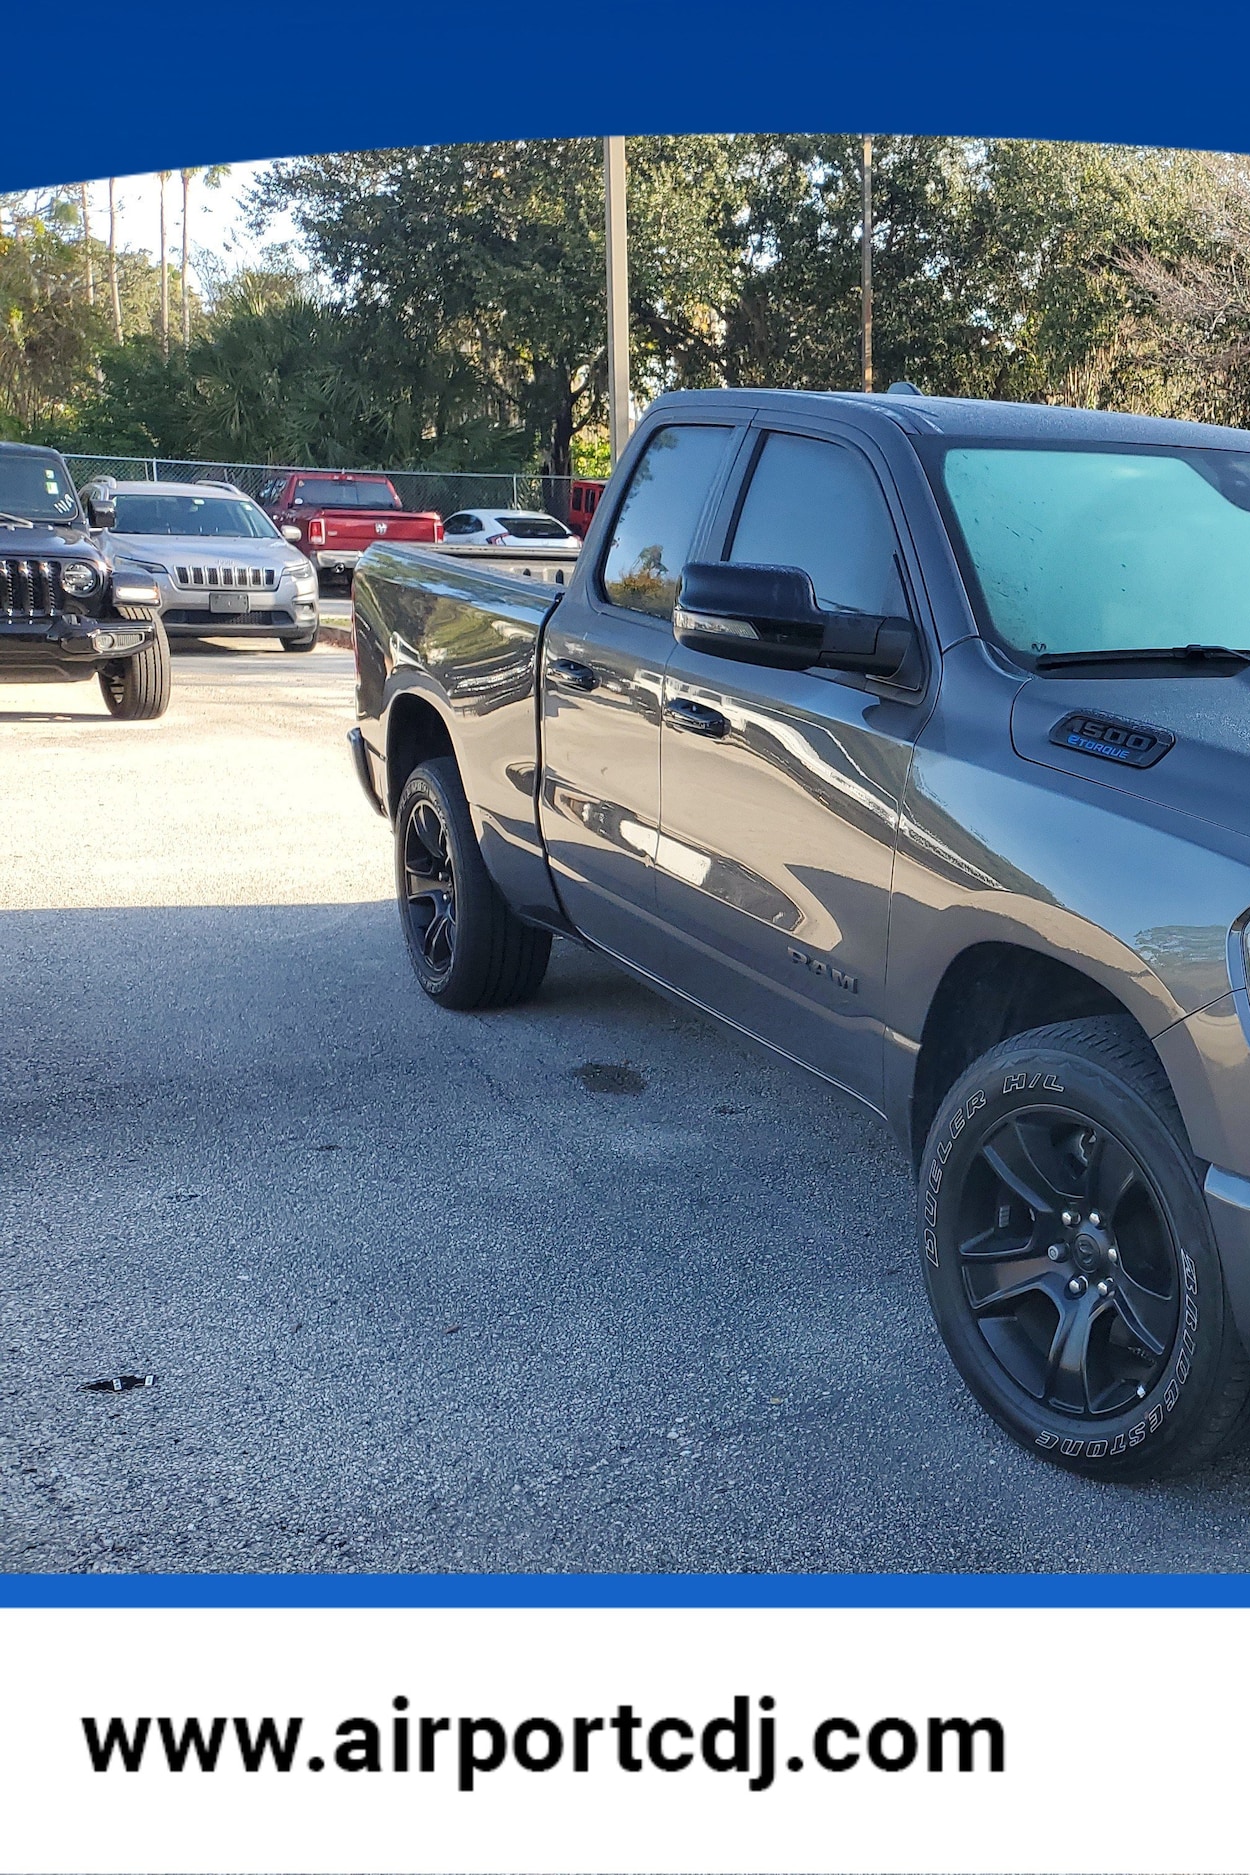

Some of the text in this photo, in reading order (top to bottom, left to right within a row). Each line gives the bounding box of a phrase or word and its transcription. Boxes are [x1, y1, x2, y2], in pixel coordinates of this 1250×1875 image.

[787, 945, 859, 994] RAM
[923, 1071, 1066, 1268] DUELER H/L
[1034, 1246, 1199, 1459] BRIDGESTONE
